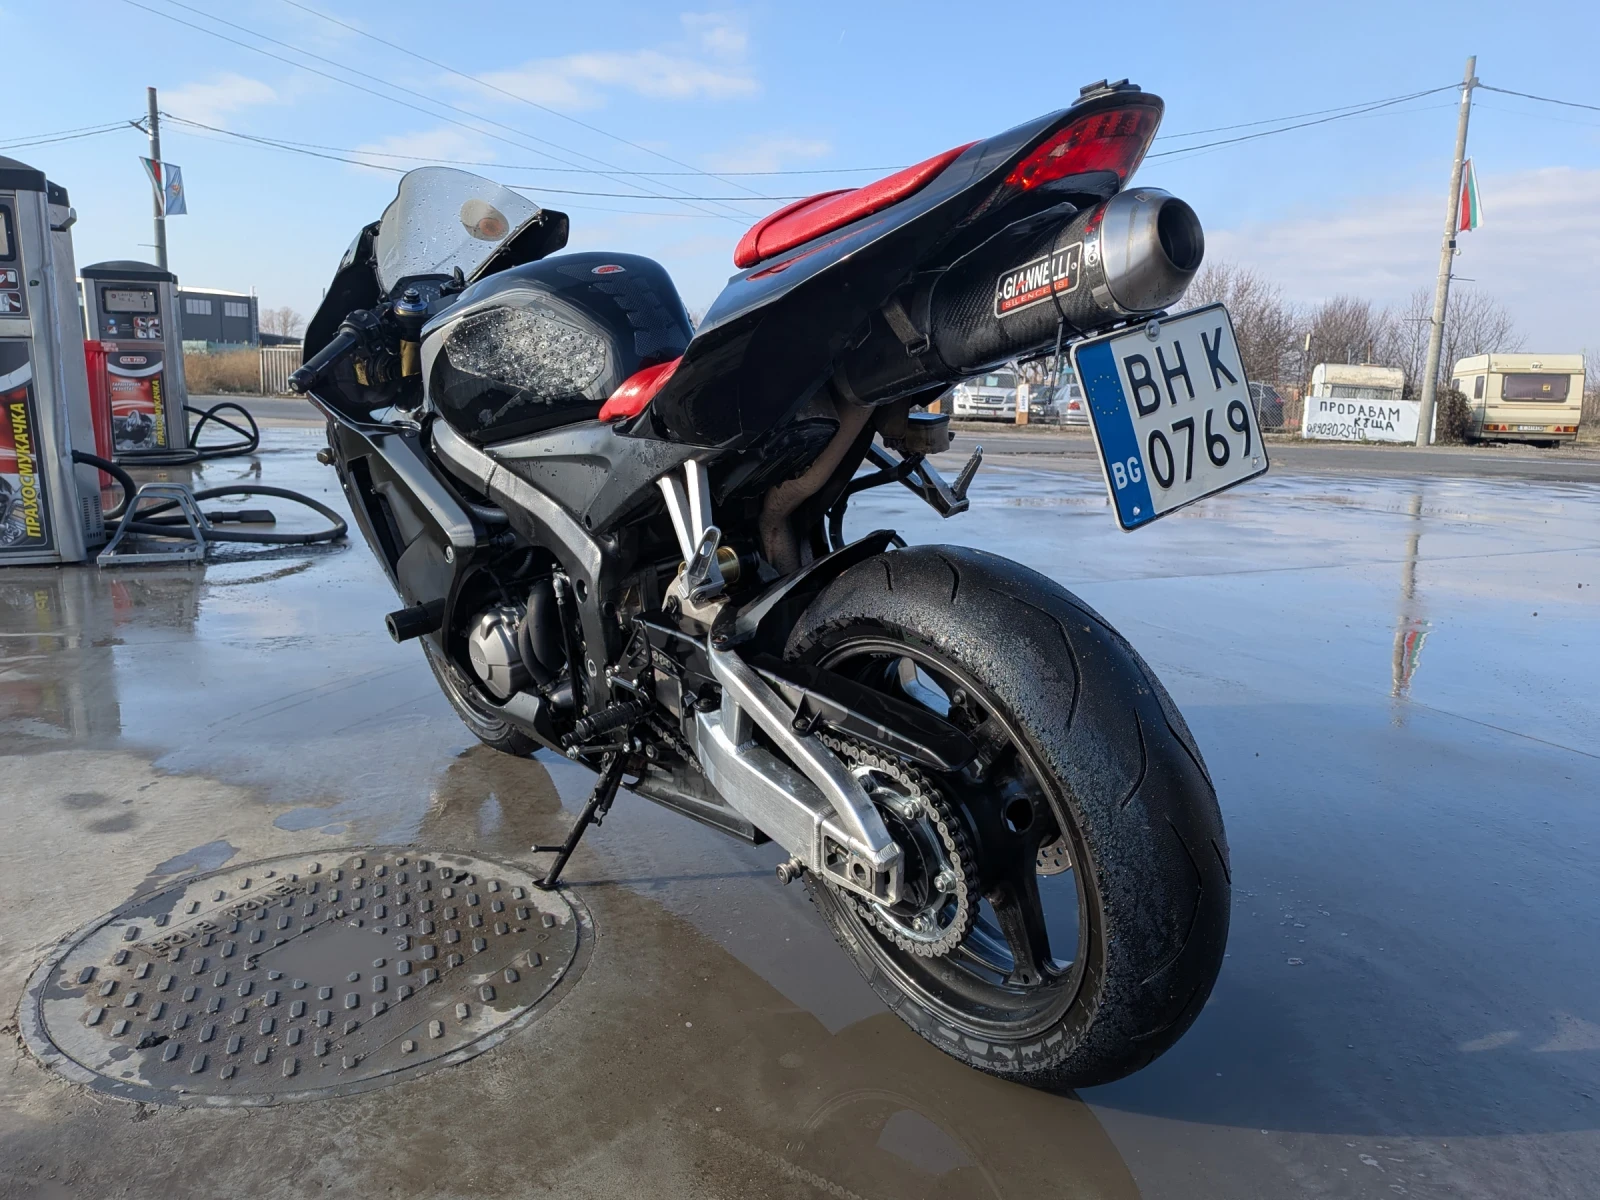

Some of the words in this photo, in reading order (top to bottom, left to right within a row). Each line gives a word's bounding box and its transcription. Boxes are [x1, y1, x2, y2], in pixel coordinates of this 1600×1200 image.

[1003, 252, 1071, 300] GIANNELLI
[1004, 281, 1066, 309] SILENCES
[1147, 400, 1251, 490] 0769
[10, 402, 42, 538] ПРАХОСМУКАЧКА
[1112, 456, 1142, 490] BG
